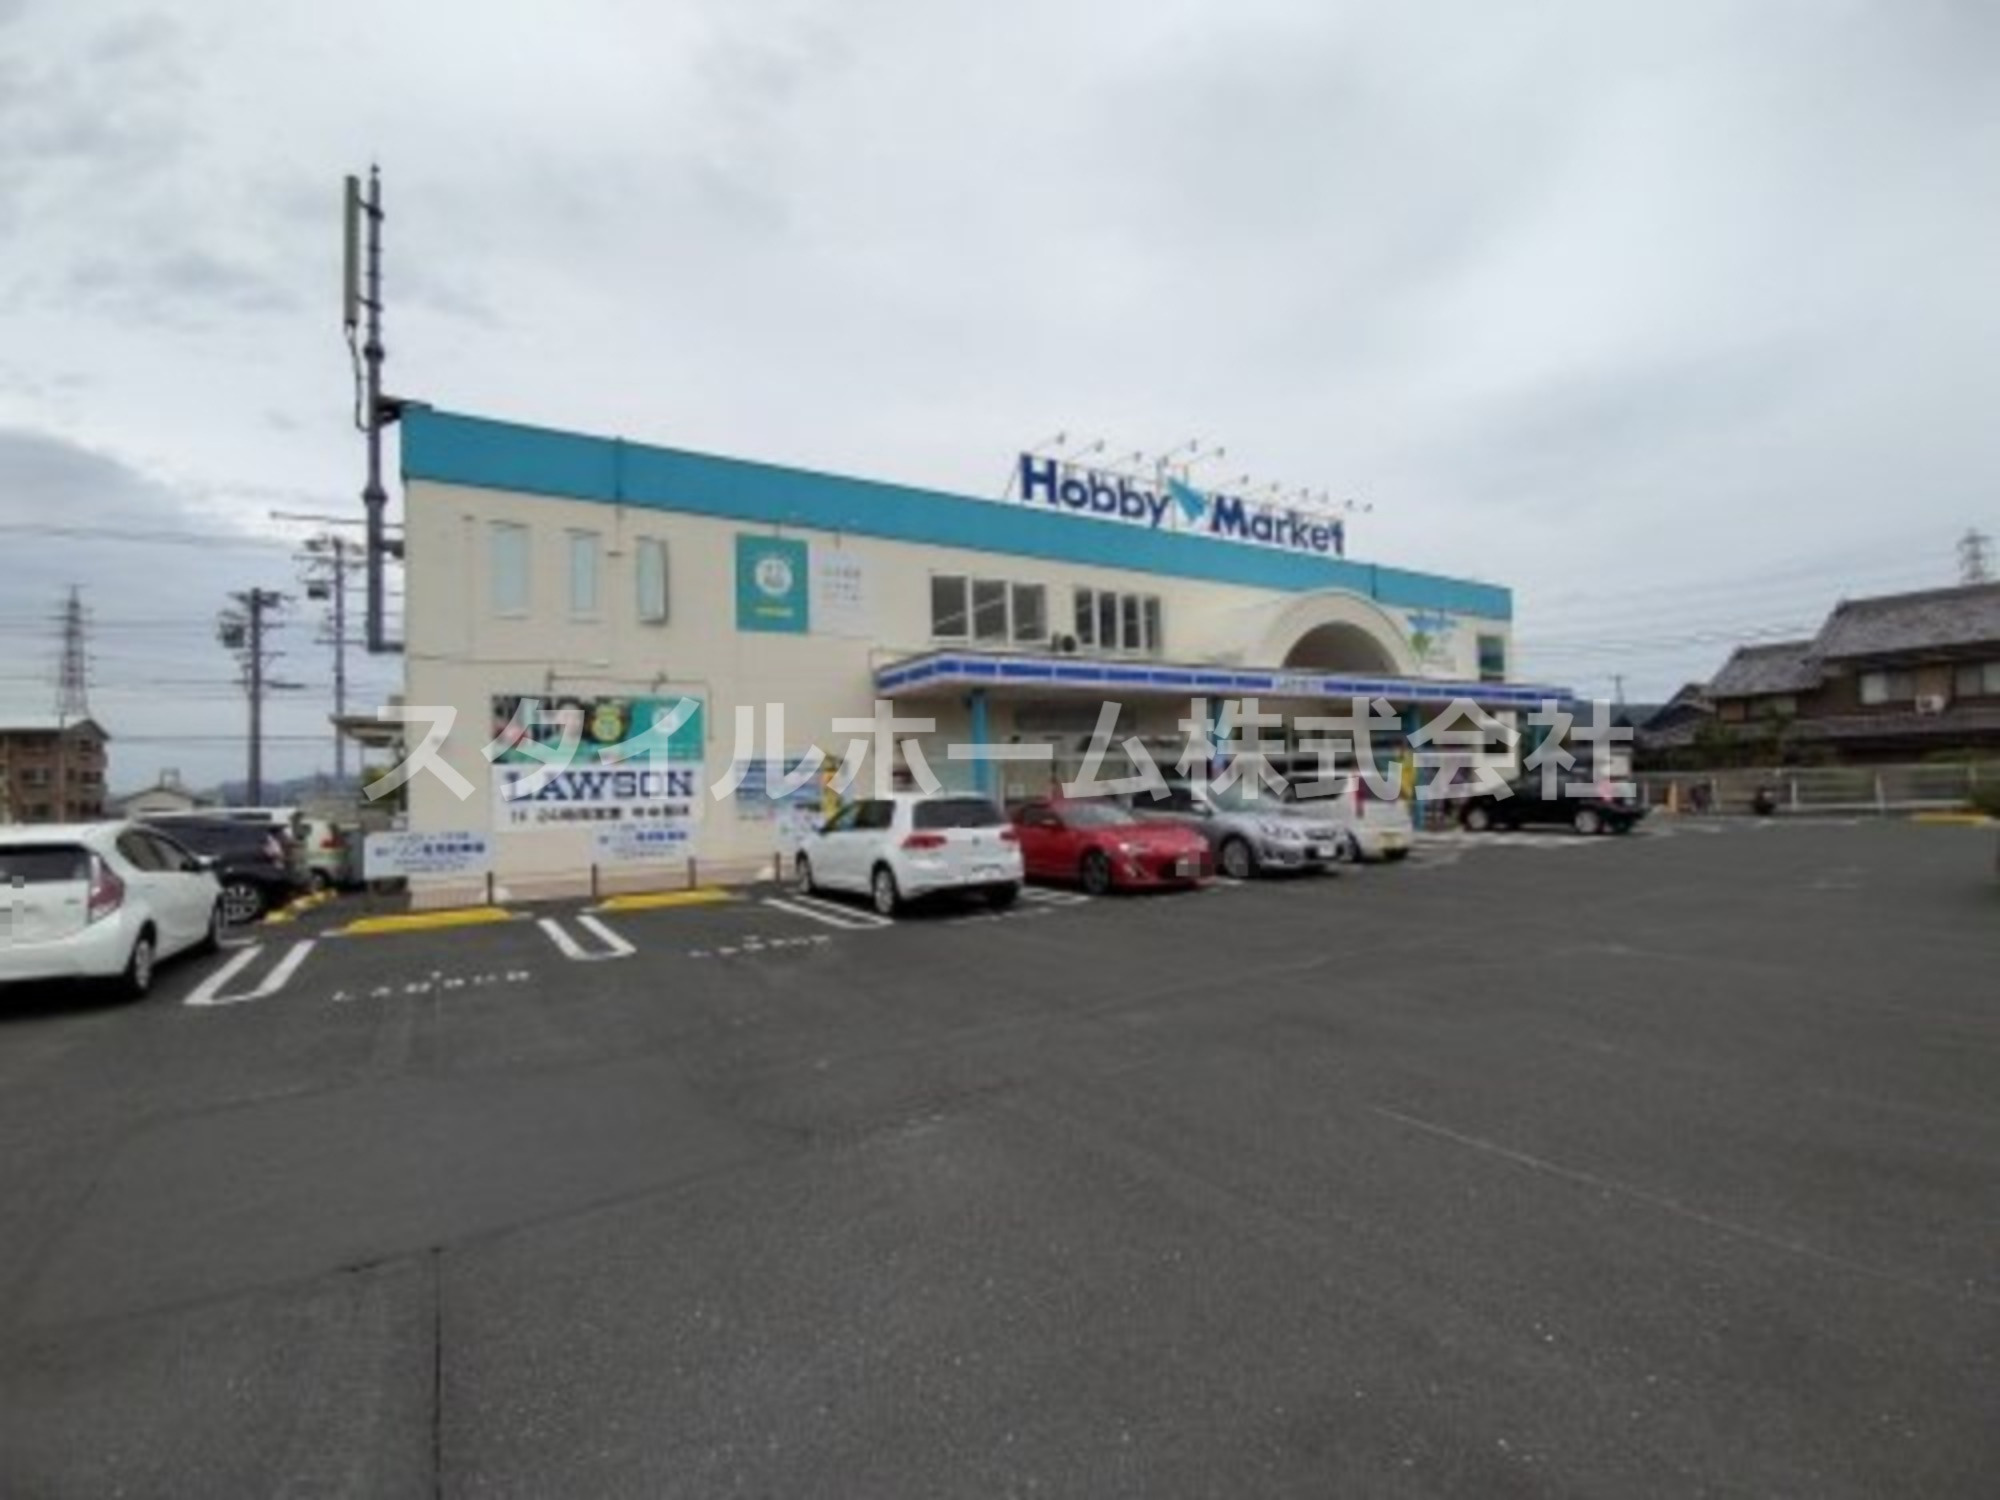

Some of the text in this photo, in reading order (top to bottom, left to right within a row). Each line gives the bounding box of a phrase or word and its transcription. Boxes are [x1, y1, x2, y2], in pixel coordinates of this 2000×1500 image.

[1020, 453, 1345, 554] Hobby Market
[505, 771, 693, 801] LAWSON
